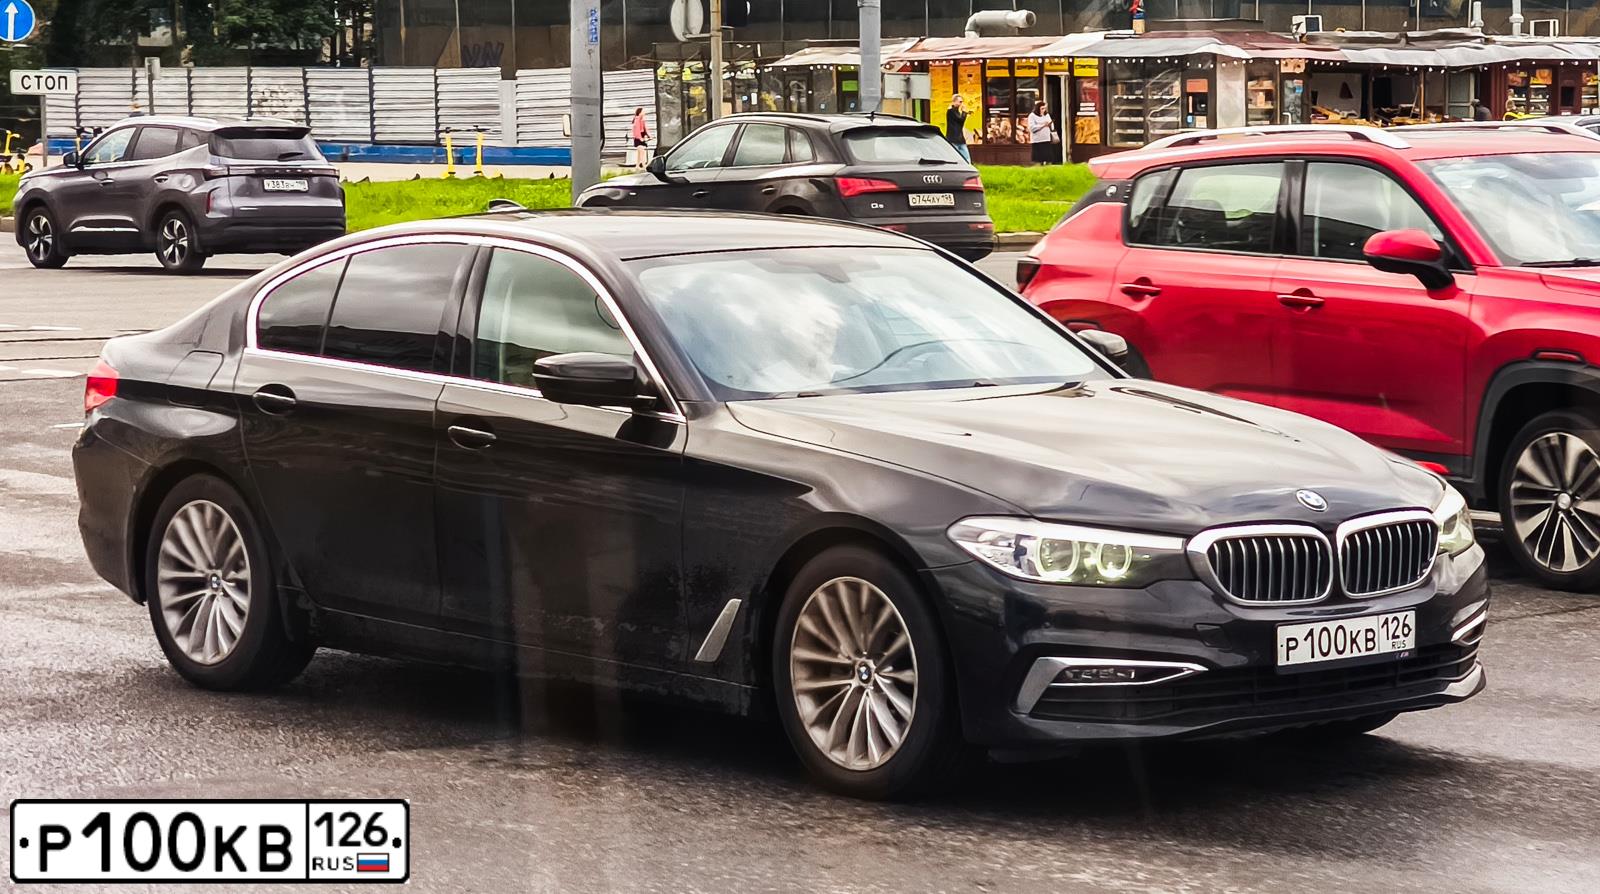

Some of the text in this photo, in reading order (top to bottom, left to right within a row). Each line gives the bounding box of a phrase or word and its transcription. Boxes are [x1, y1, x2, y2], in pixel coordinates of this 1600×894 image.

[21, 75, 68, 90] СТОП
[1285, 614, 1411, 661] Р100КВ 126
[1391, 640, 1407, 650] RUS
